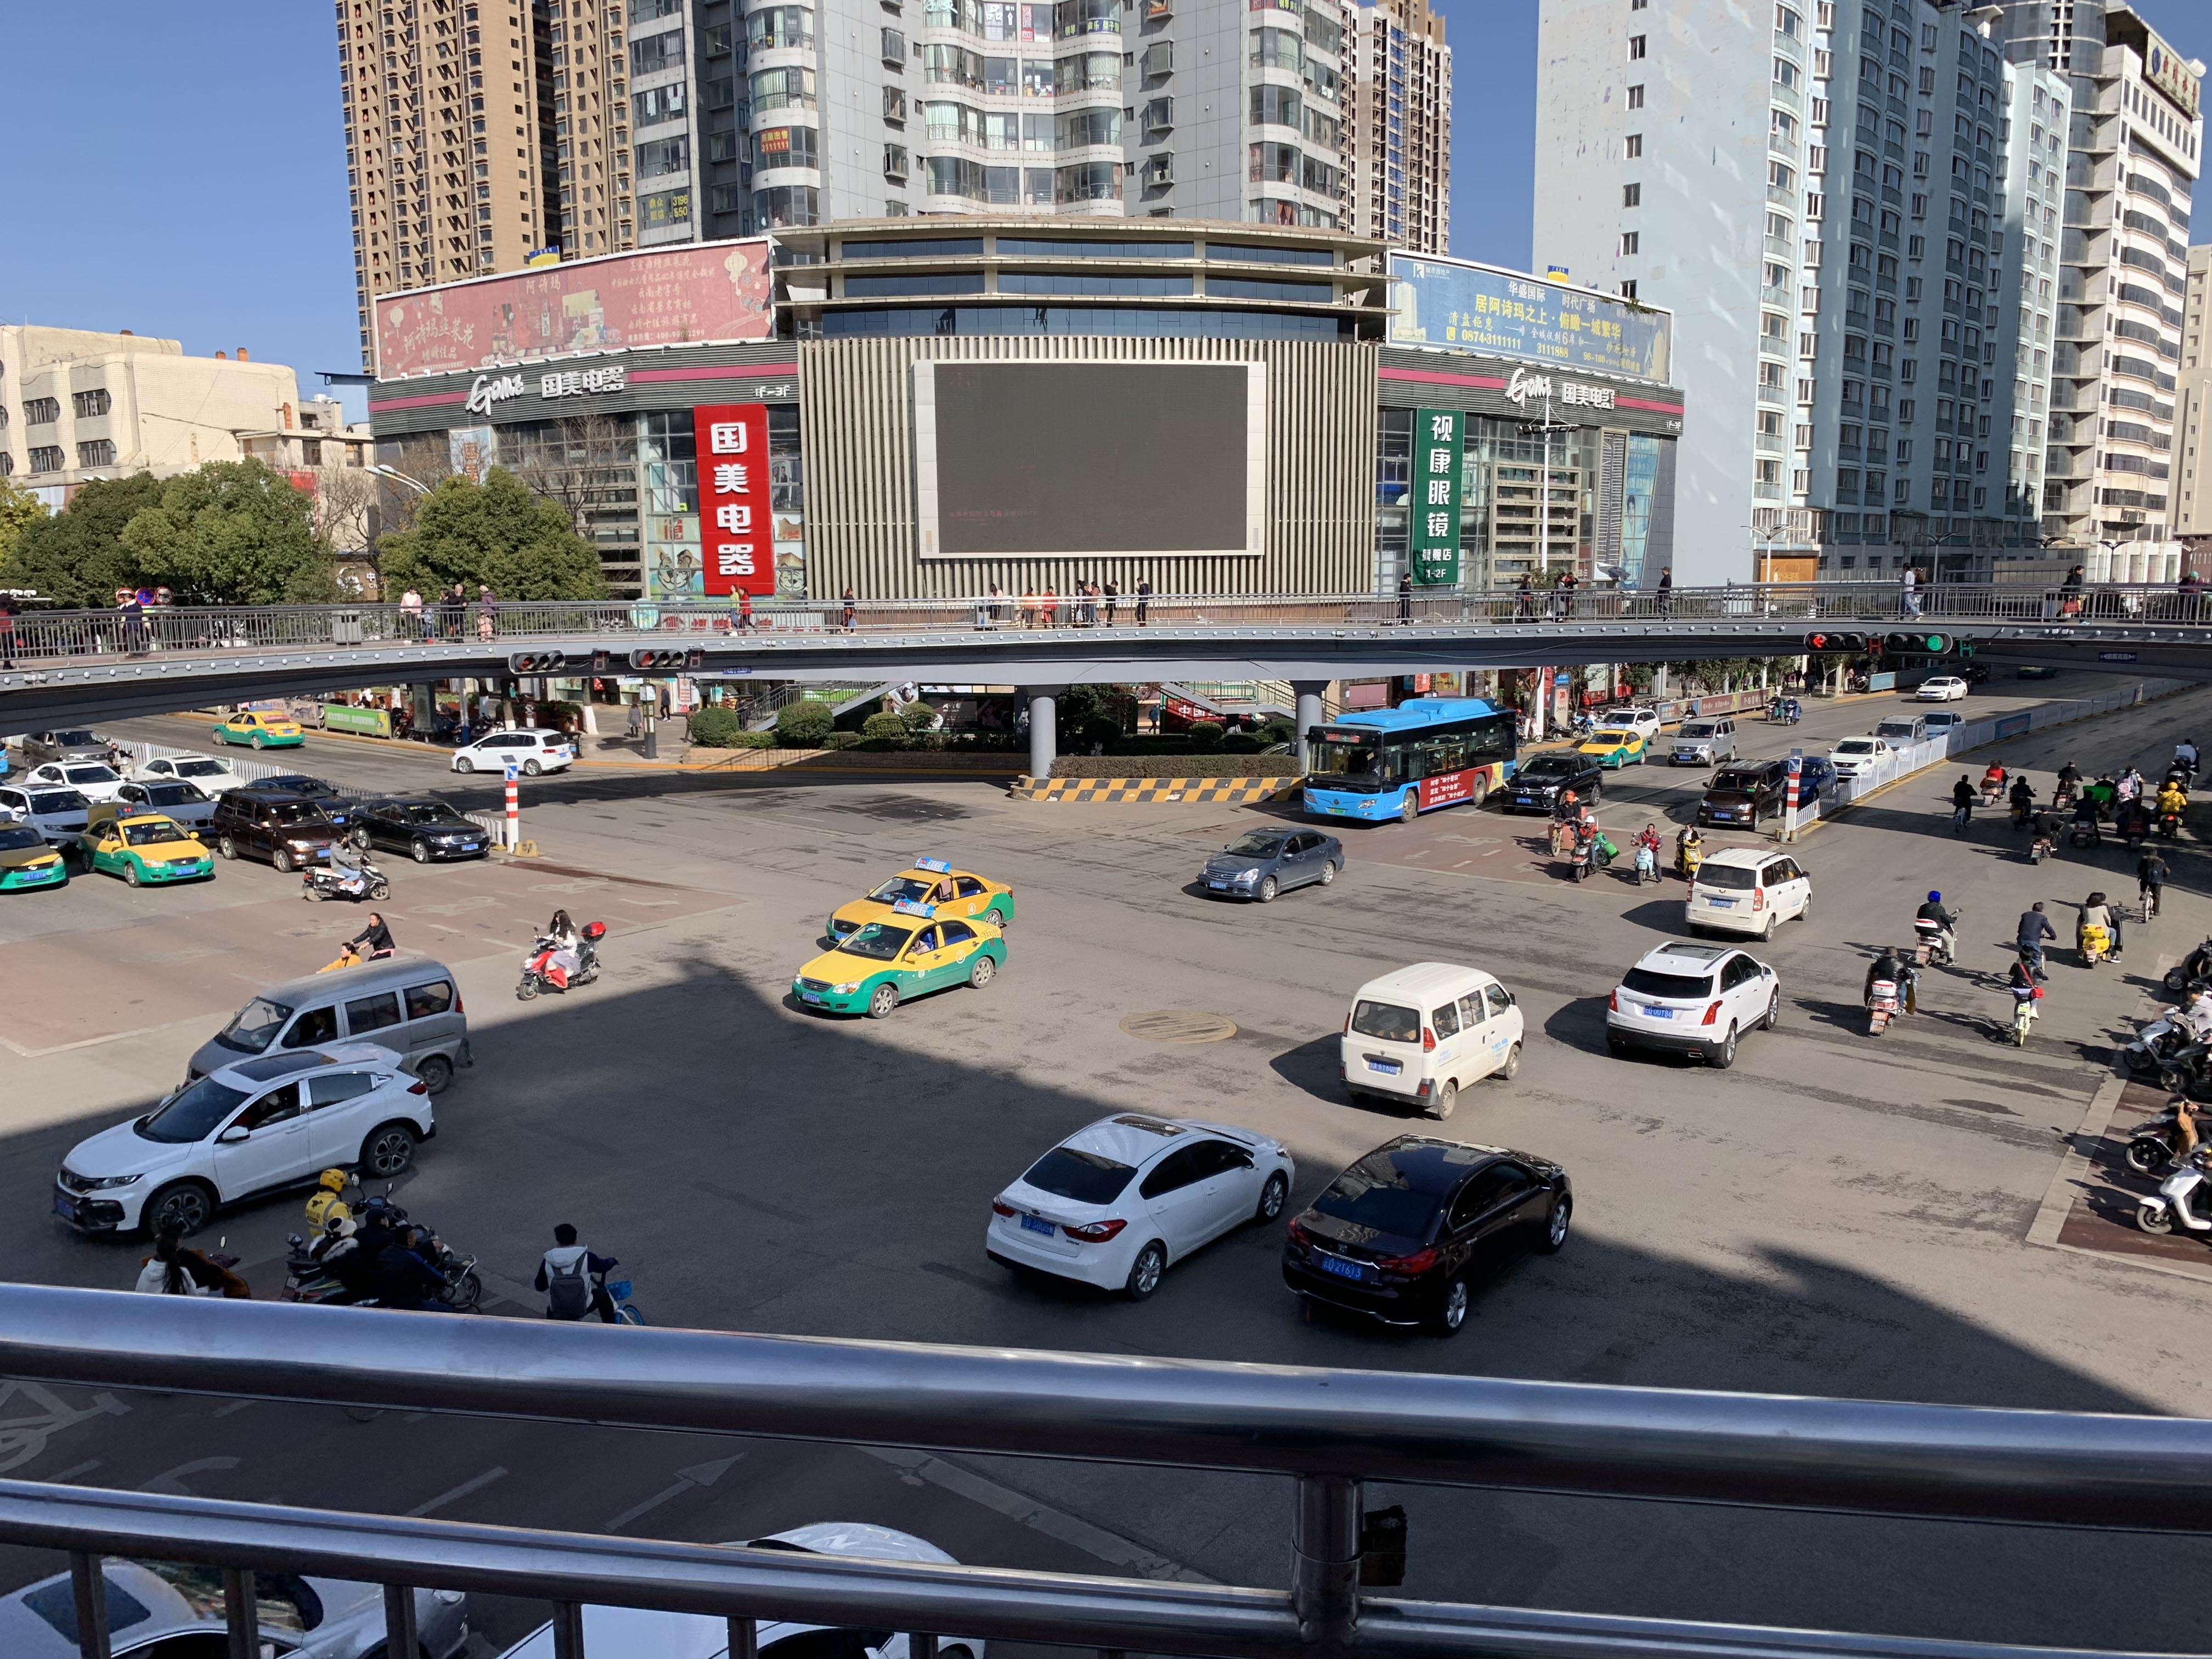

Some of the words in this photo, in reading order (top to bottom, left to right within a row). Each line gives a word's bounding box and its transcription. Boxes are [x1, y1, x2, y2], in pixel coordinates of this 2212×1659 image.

[761, 140, 789, 153] 3111111
[673, 195, 689, 206] 3196
[674, 206, 687, 218] 550
[526, 274, 561, 294] 阿诗玛
[638, 283, 681, 298] 云南老字号
[1508, 280, 1545, 302] 华盛国际
[1562, 294, 1595, 314] 时代广场
[632, 298, 692, 315] 云南省著名商标
[404, 317, 474, 354] 阿诗玛韭菜花
[541, 365, 624, 398] 国美电器
[1561, 383, 1615, 410] 国美电器
[1427, 415, 1454, 538] 视康眼镜
[710, 422, 755, 577] 国美电器
[1422, 549, 1452, 562] 旗舰店
[1425, 568, 1446, 580] 1-2F
